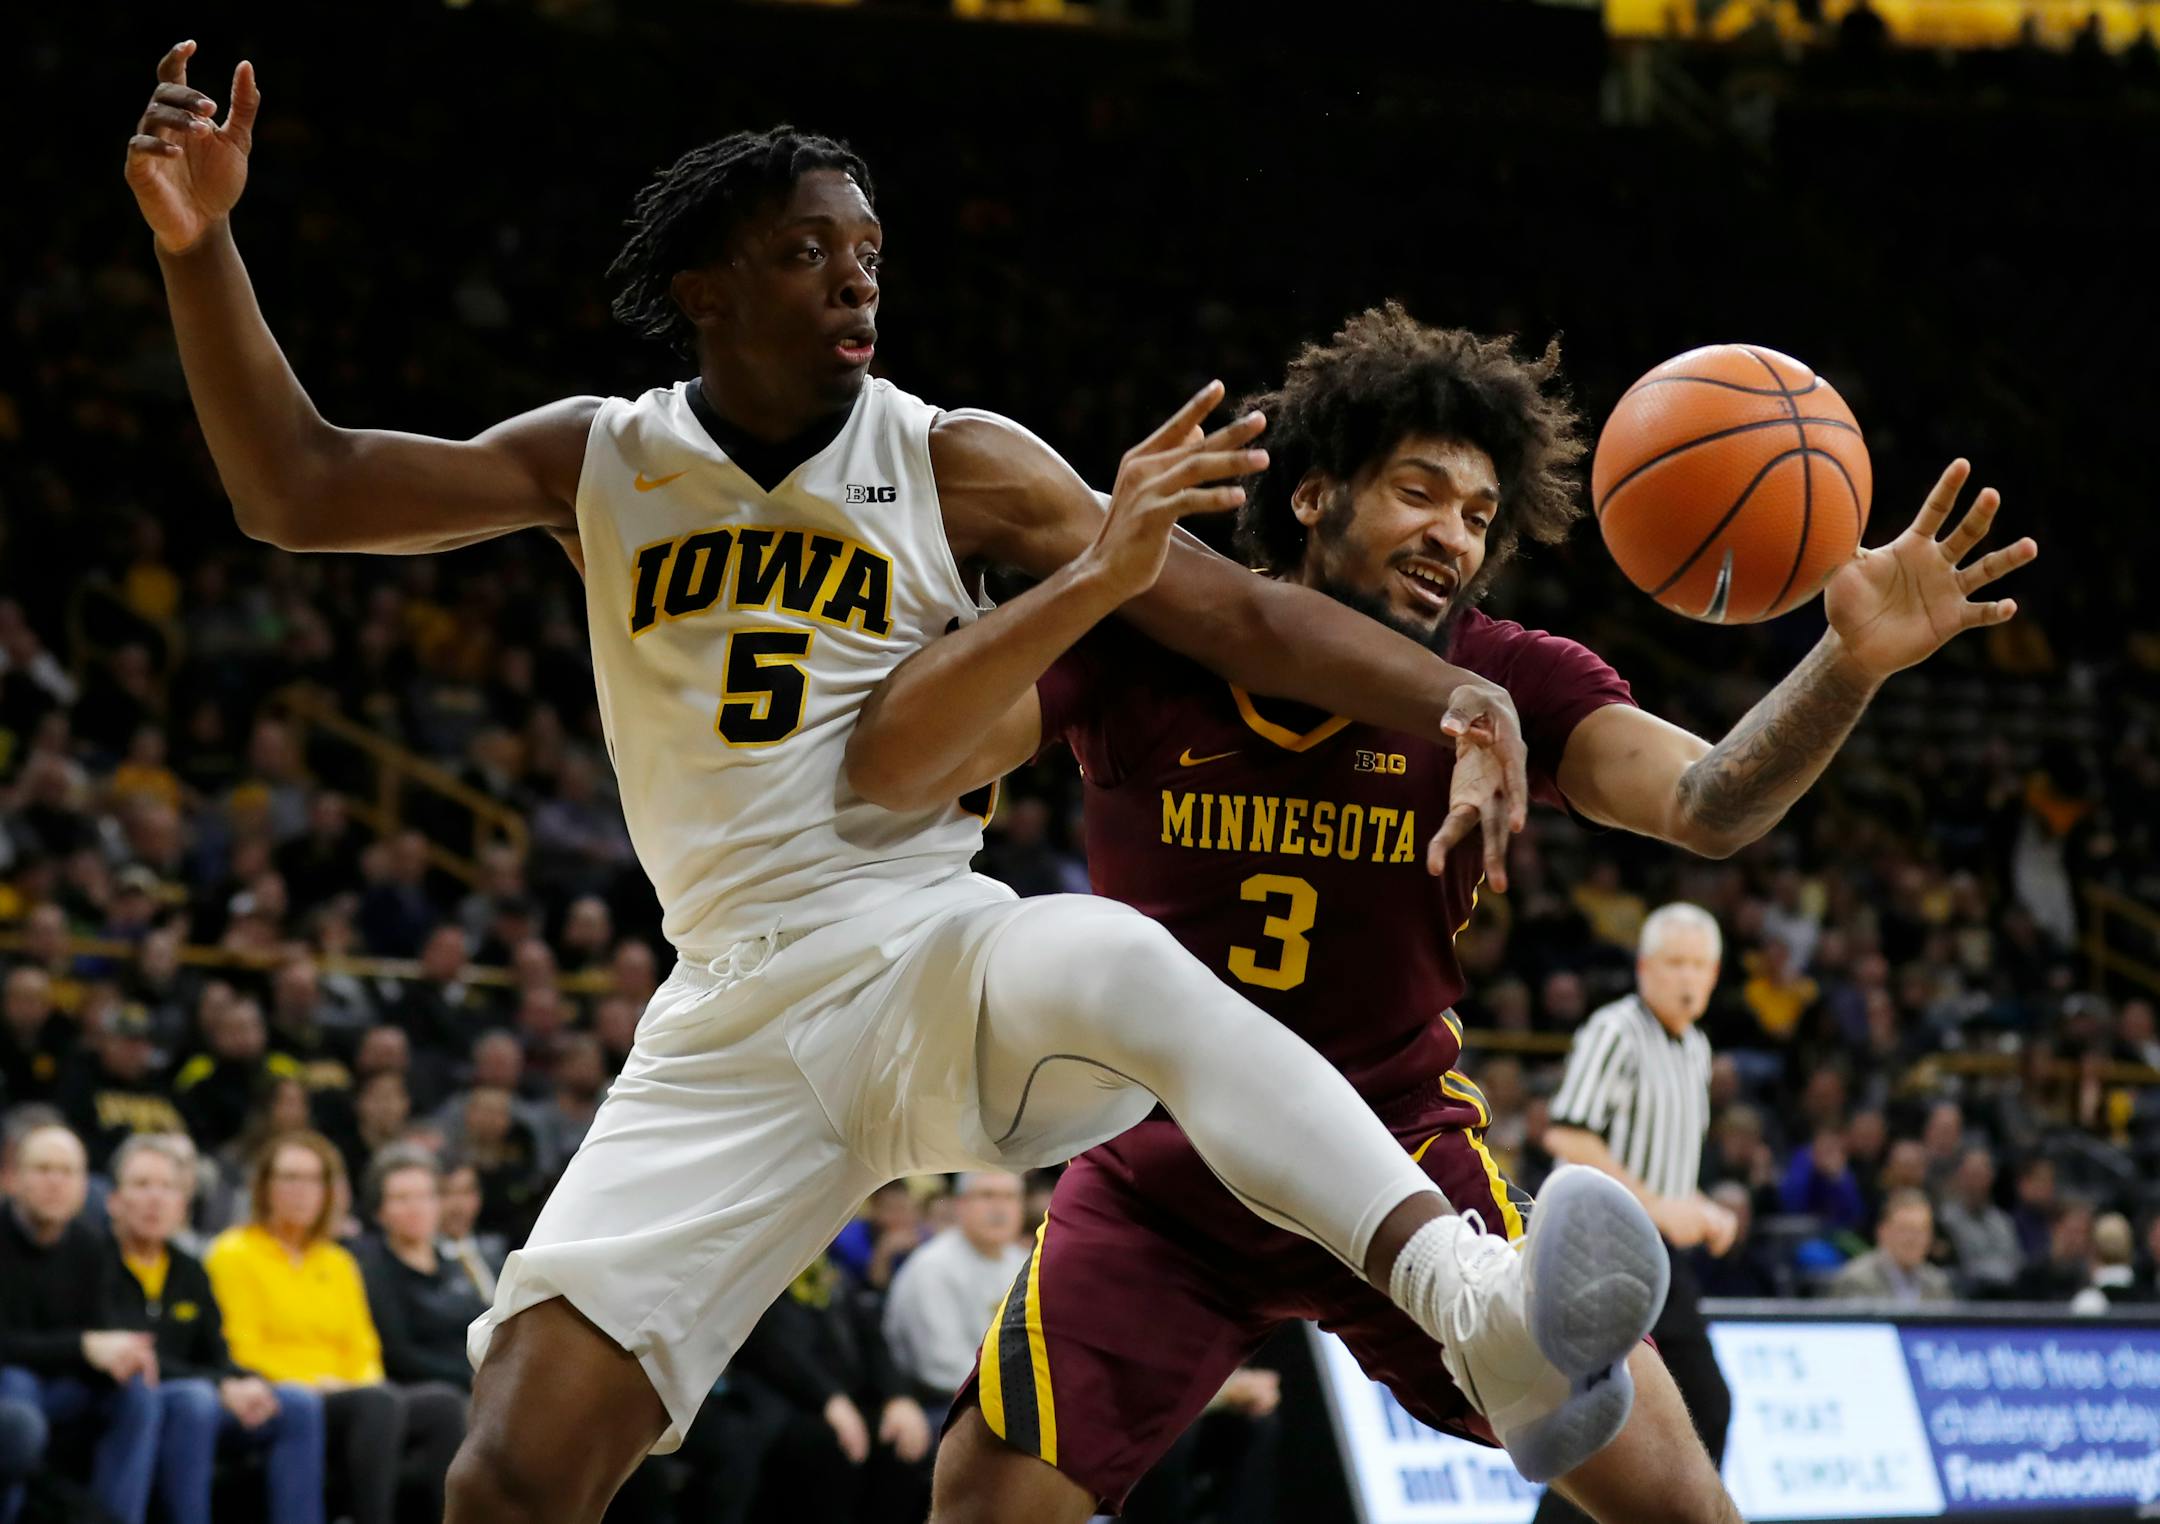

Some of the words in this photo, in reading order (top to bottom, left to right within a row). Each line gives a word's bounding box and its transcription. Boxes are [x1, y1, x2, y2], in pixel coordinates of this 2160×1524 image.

[628, 523, 895, 640] IOWA
[714, 626, 816, 749] 5
[1161, 790, 1415, 863] MINNESOTA
[1227, 873, 1318, 991] 3
[1912, 1341, 1991, 1390] Take
[1989, 1341, 2047, 1390] the
[2042, 1339, 2108, 1390] free
[1756, 1399, 1844, 1436] THAT
[1931, 1396, 2078, 1451] challenge
